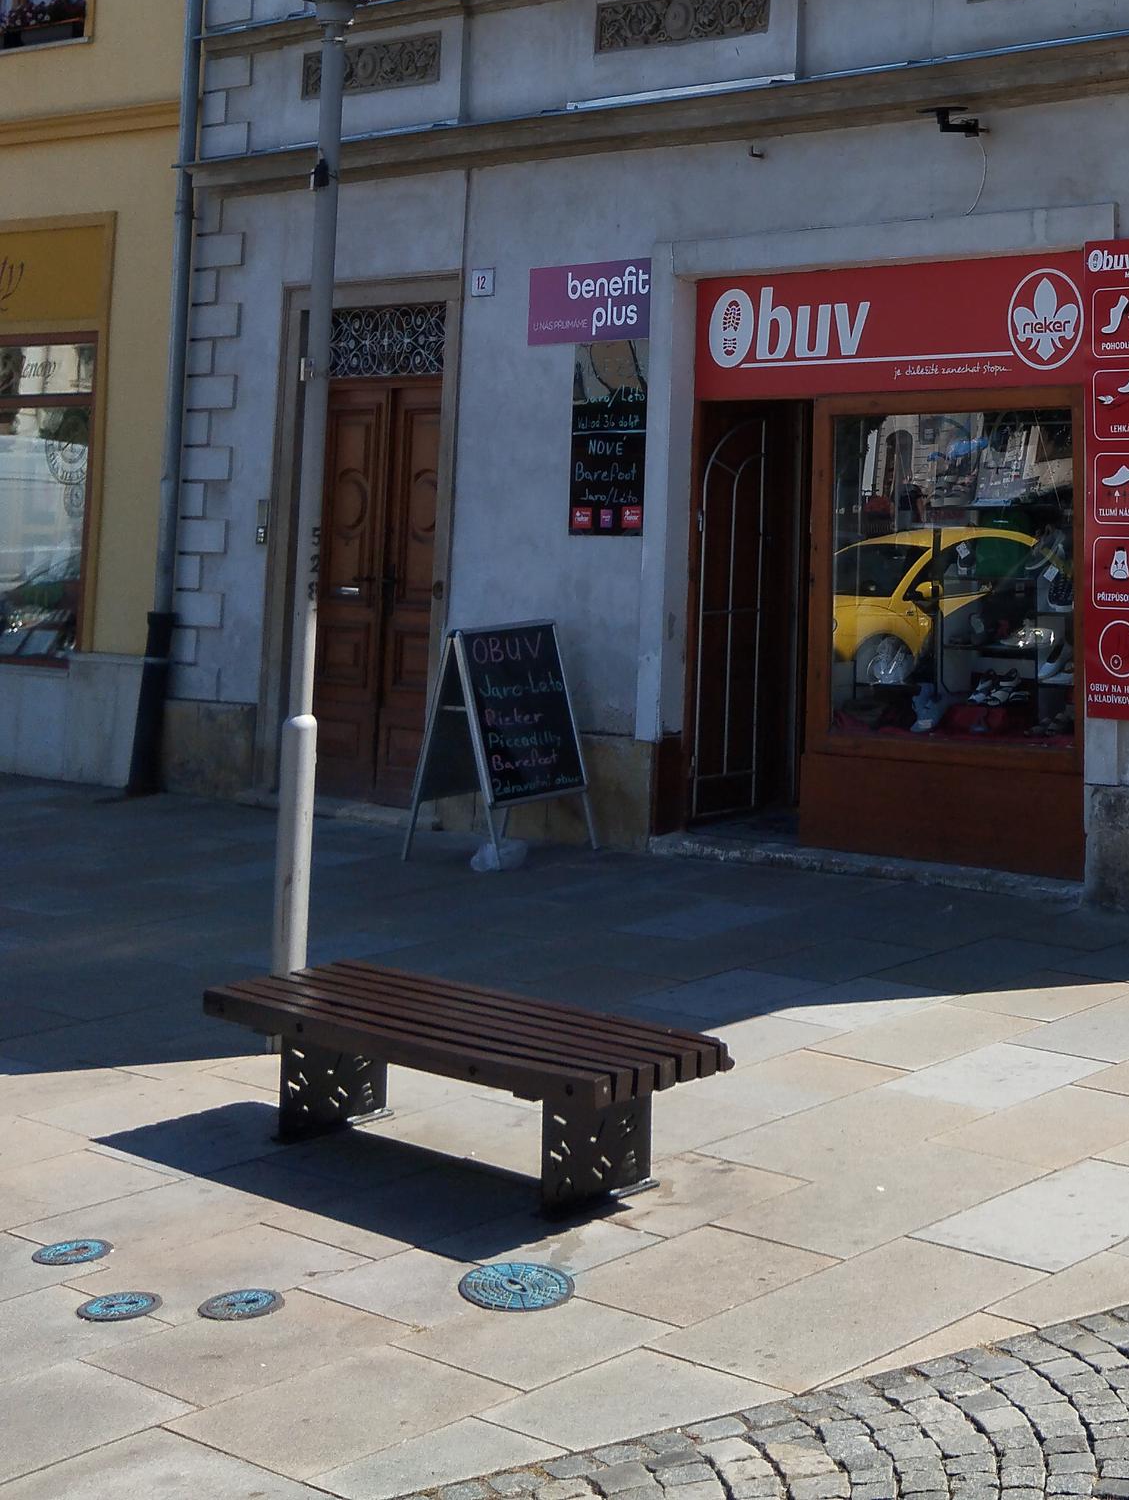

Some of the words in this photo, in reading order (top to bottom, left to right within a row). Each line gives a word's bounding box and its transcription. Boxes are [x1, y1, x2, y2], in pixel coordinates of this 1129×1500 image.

[477, 275, 486, 290] 12
[567, 265, 650, 300] benefit
[591, 298, 638, 335] plus
[1022, 316, 1071, 334] rieker
[709, 286, 871, 368] Obuv
[588, 436, 627, 455] NOVÉ
[575, 461, 637, 481] Barefoot
[1099, 507, 1118, 516] TLUMÍ
[472, 632, 542, 664] OBUV
[1090, 683, 1109, 692] OBUV
[1111, 685, 1122, 693] NA
[1088, 694, 1093, 702] A
